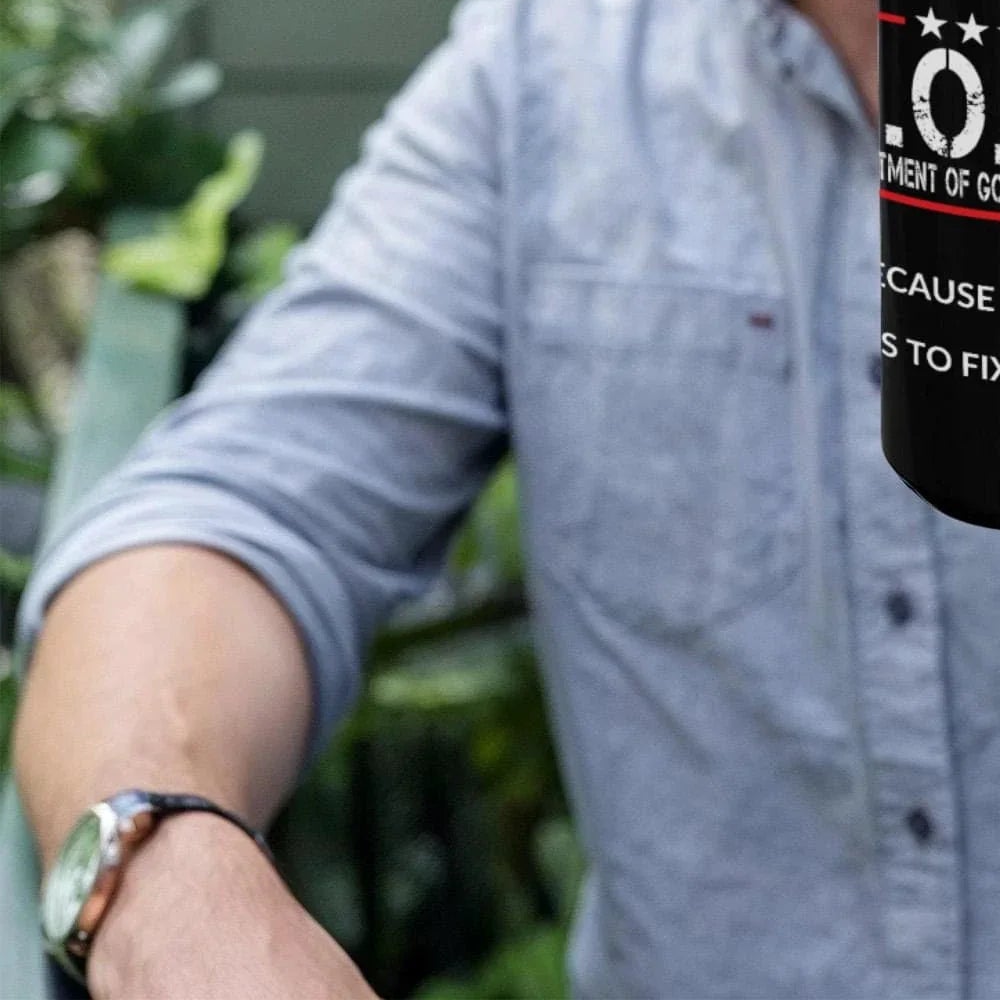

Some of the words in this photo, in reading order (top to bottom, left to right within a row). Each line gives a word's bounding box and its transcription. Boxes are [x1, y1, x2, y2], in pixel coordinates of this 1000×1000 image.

[945, 166, 970, 197] OF
[881, 331, 898, 358] S
[906, 338, 952, 372] TO
